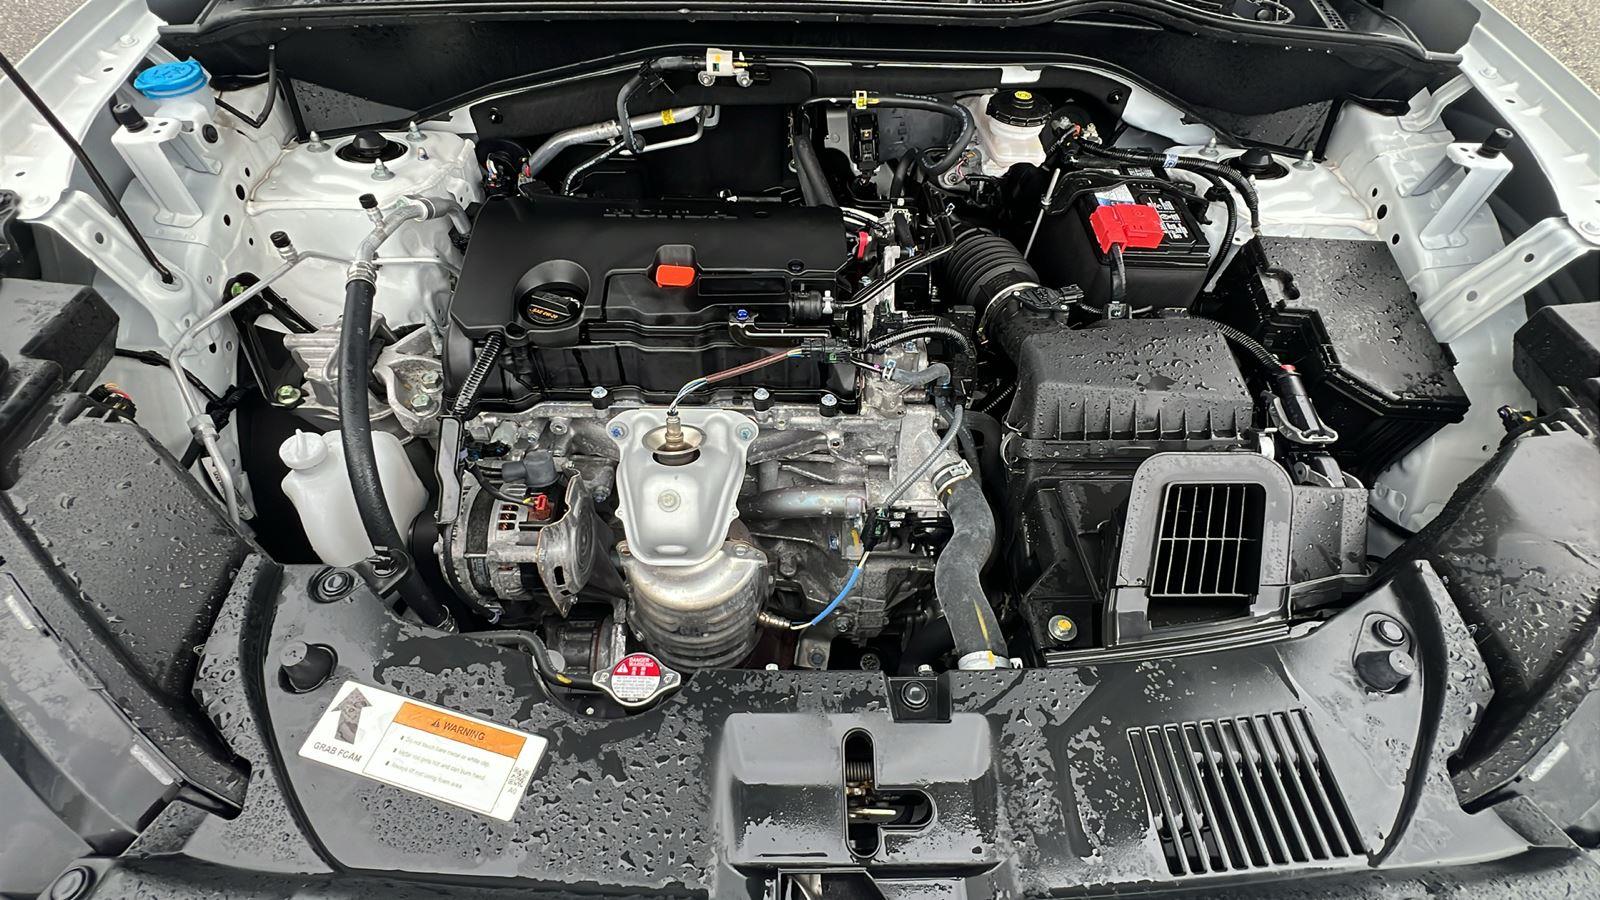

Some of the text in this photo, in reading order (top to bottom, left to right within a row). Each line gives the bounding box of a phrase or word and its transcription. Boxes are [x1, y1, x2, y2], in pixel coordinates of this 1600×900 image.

[442, 722, 486, 740] WARNING
[313, 742, 362, 762] GRAB FOAM
